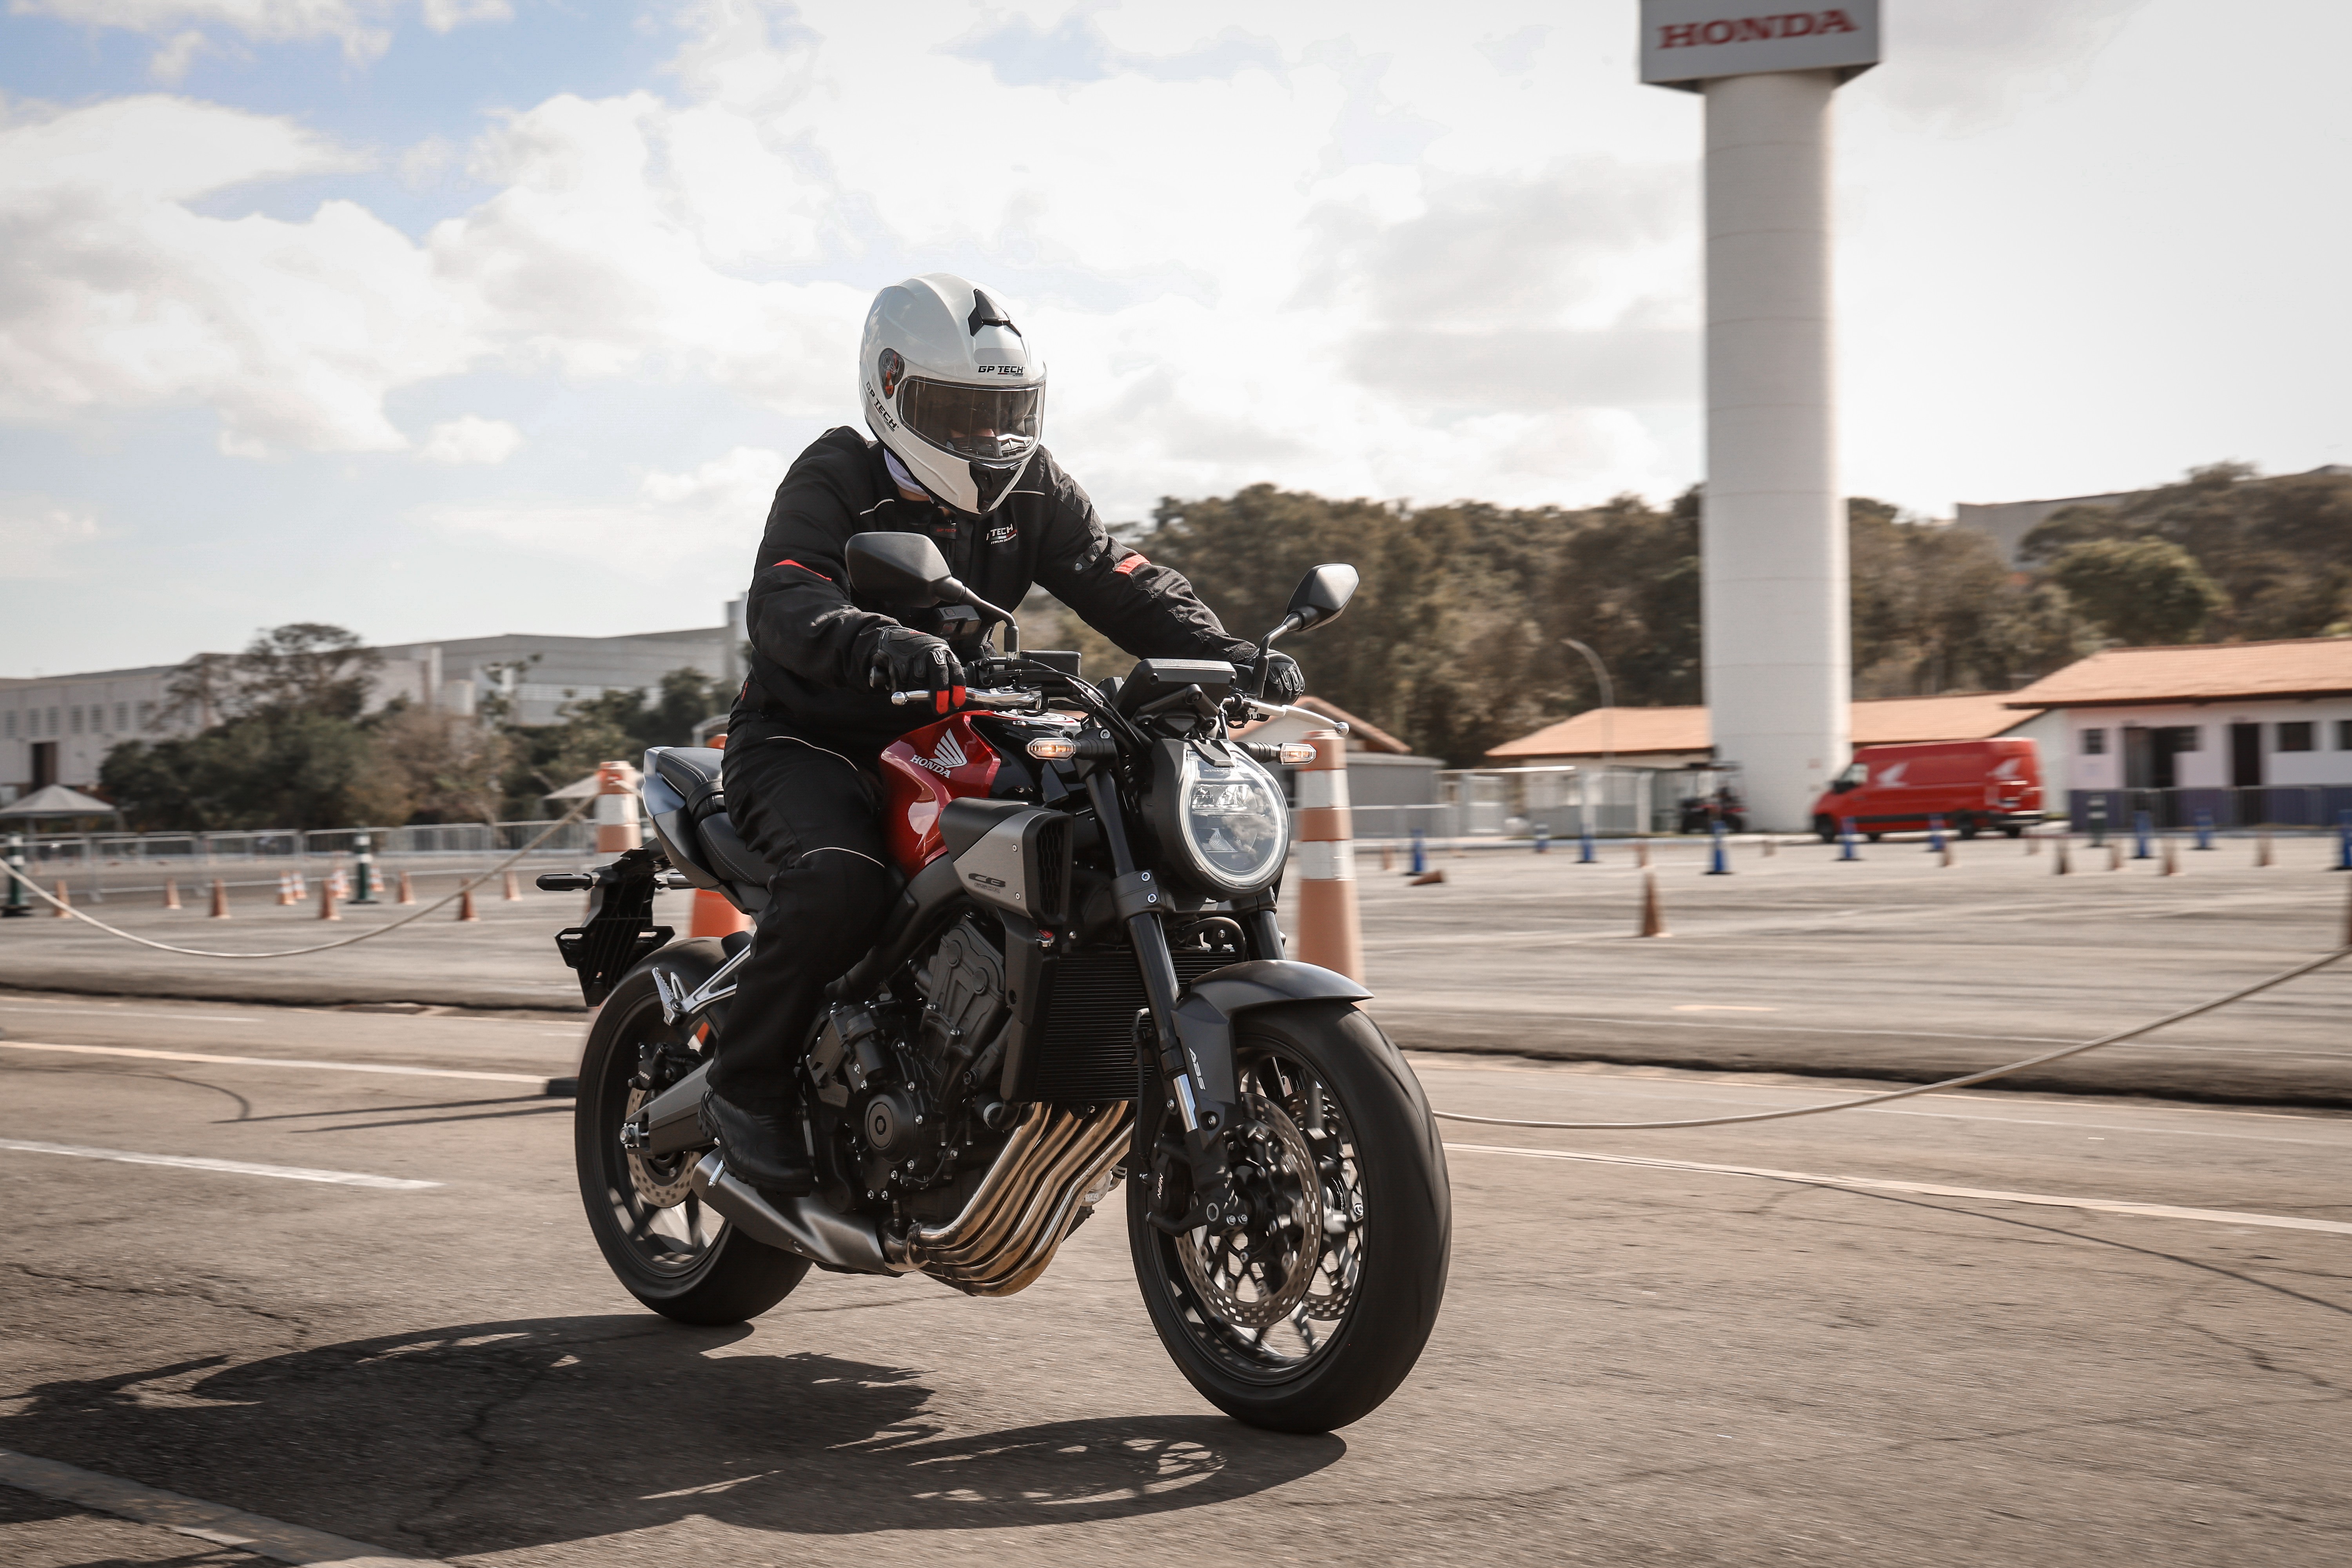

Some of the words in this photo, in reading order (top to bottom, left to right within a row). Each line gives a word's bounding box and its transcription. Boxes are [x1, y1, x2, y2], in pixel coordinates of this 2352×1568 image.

[1656, 9, 1860, 49] HONDA
[866, 381, 875, 397] GP
[875, 397, 897, 428] TECH
[990, 523, 1013, 537] TECH
[909, 754, 951, 779] HONDA
[968, 873, 1005, 887] CB
[1189, 1047, 1206, 1090] ABS
